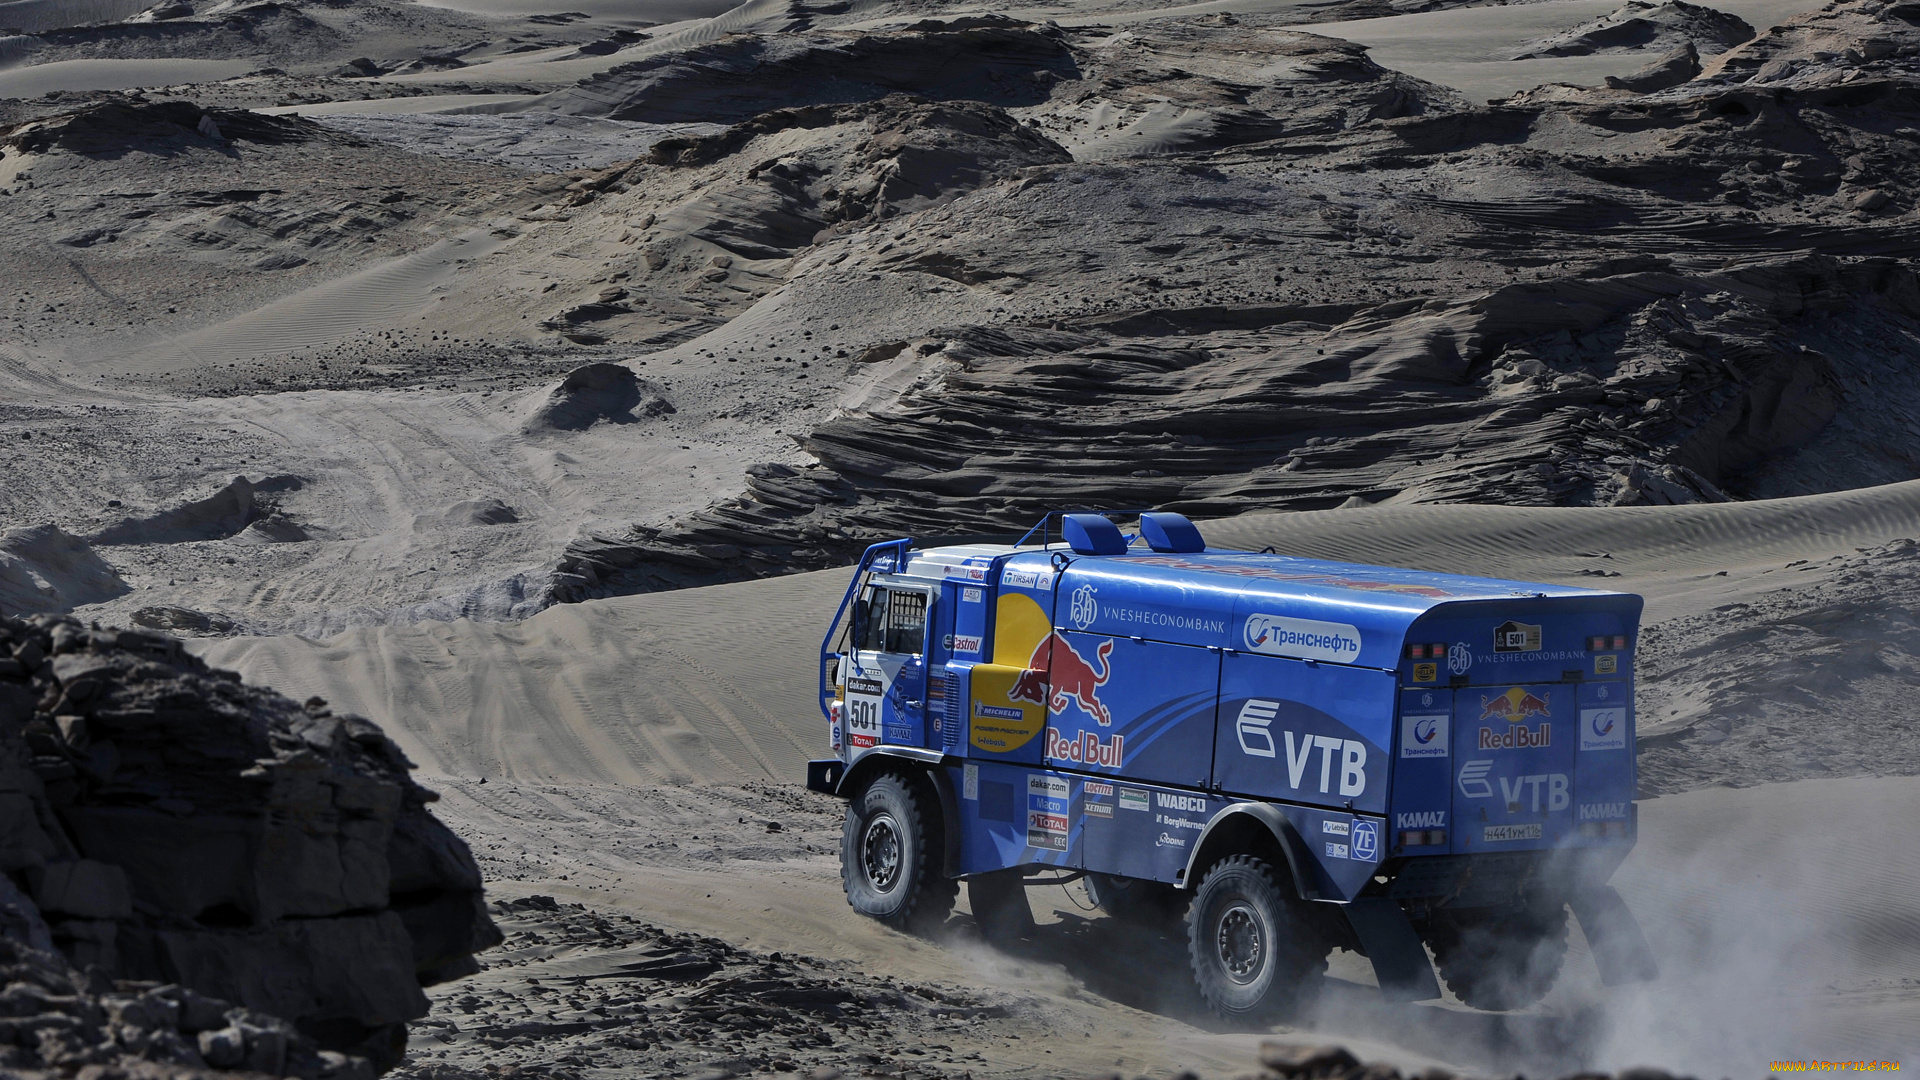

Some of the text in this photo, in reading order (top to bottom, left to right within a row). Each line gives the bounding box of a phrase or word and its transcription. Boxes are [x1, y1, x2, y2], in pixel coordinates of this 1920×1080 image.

[1103, 606, 1225, 634] VNESHECONOMBANK
[953, 636, 979, 651] Castrol
[1271, 626, 1357, 653] Транснефть
[1509, 633, 1524, 645] 501
[1478, 651, 1586, 663] VNESHECONOMBANK
[849, 681, 881, 693] dakar.com
[851, 700, 877, 731] 501
[983, 707, 1022, 718] MICHELIN
[853, 736, 874, 746] TOTAL
[978, 737, 1006, 747] Webasto
[1479, 723, 1551, 750] Red Bull
[1045, 727, 1125, 769] Red Bull
[1405, 748, 1445, 756] Транснефть
[1284, 730, 1367, 798] VTB
[1030, 779, 1066, 792] dakar.com
[1085, 782, 1112, 795] LOCTITE
[1499, 774, 1570, 813] VTB
[1036, 798, 1061, 811] Macro
[1156, 793, 1206, 813] WABCO
[1580, 802, 1626, 820] KAMAZ
[1040, 816, 1066, 830] TOTAL
[1164, 815, 1206, 830] BorgWarner
[1397, 811, 1446, 829] KAMAZ
[1356, 830, 1375, 852] ZF
